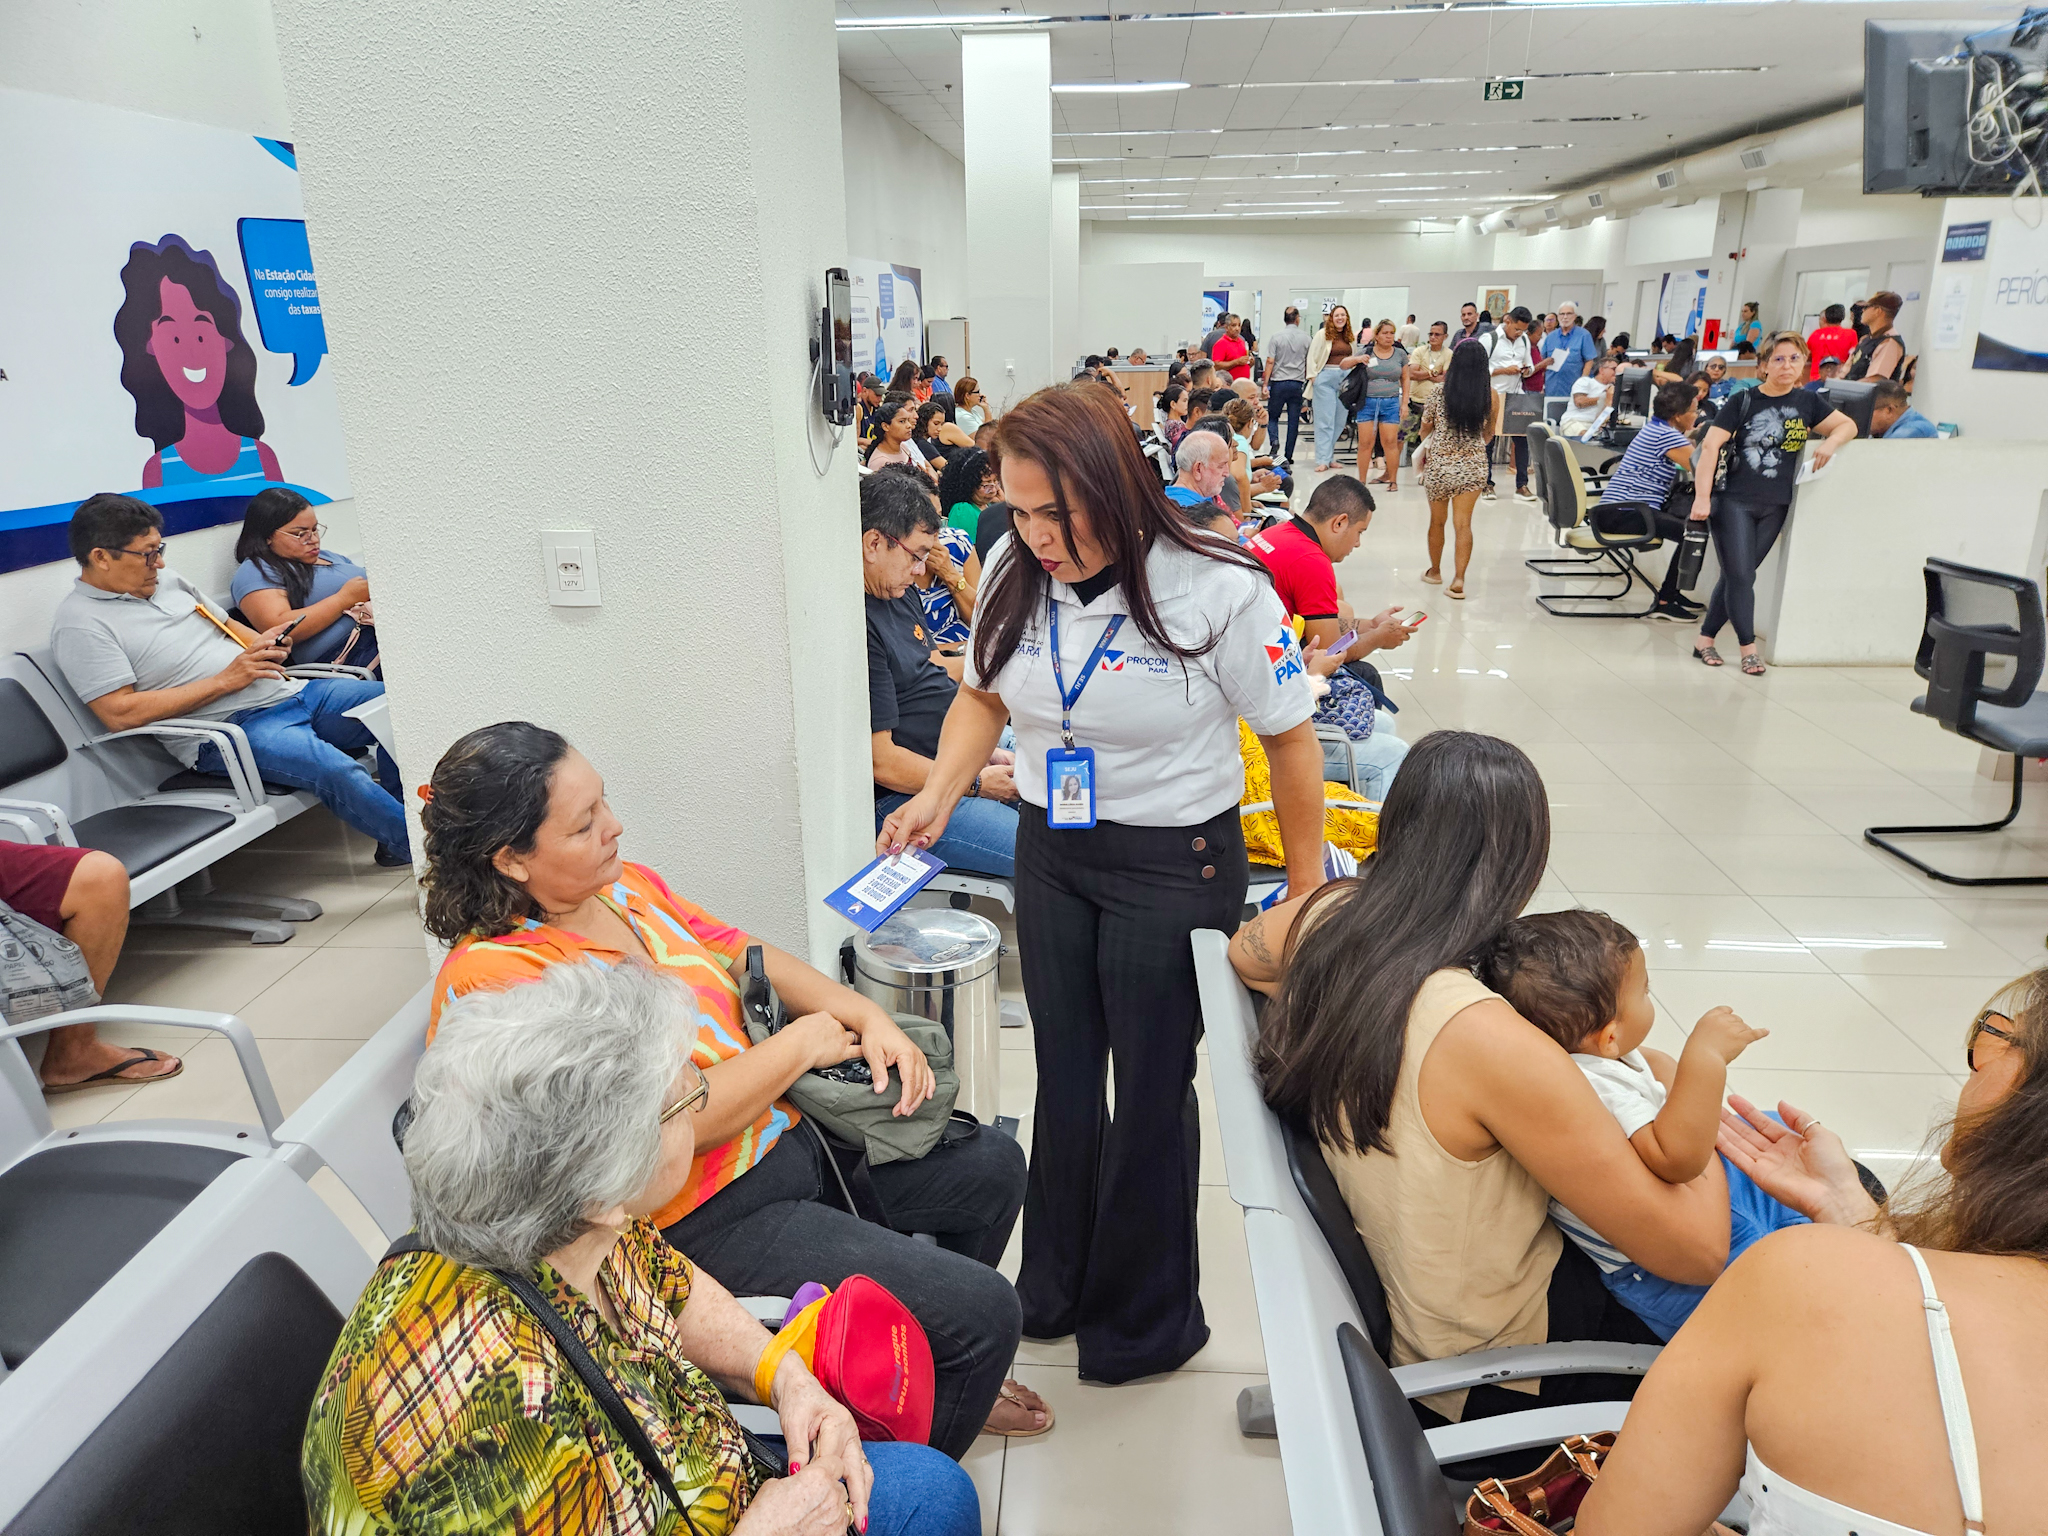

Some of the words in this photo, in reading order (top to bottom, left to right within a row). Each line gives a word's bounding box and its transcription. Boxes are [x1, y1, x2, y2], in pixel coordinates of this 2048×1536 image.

[254, 269, 265, 280] Na
[265, 269, 295, 283] Estação
[264, 287, 293, 300] consigo
[288, 303, 301, 315] das
[301, 305, 320, 314] taxas
[1126, 656, 1168, 667] PROCON
[1074, 673, 1086, 690] SEJU
[4, 962, 26, 970] PAPEL
[900, 1324, 909, 1375] sonhos
[897, 1377, 909, 1415] seus
